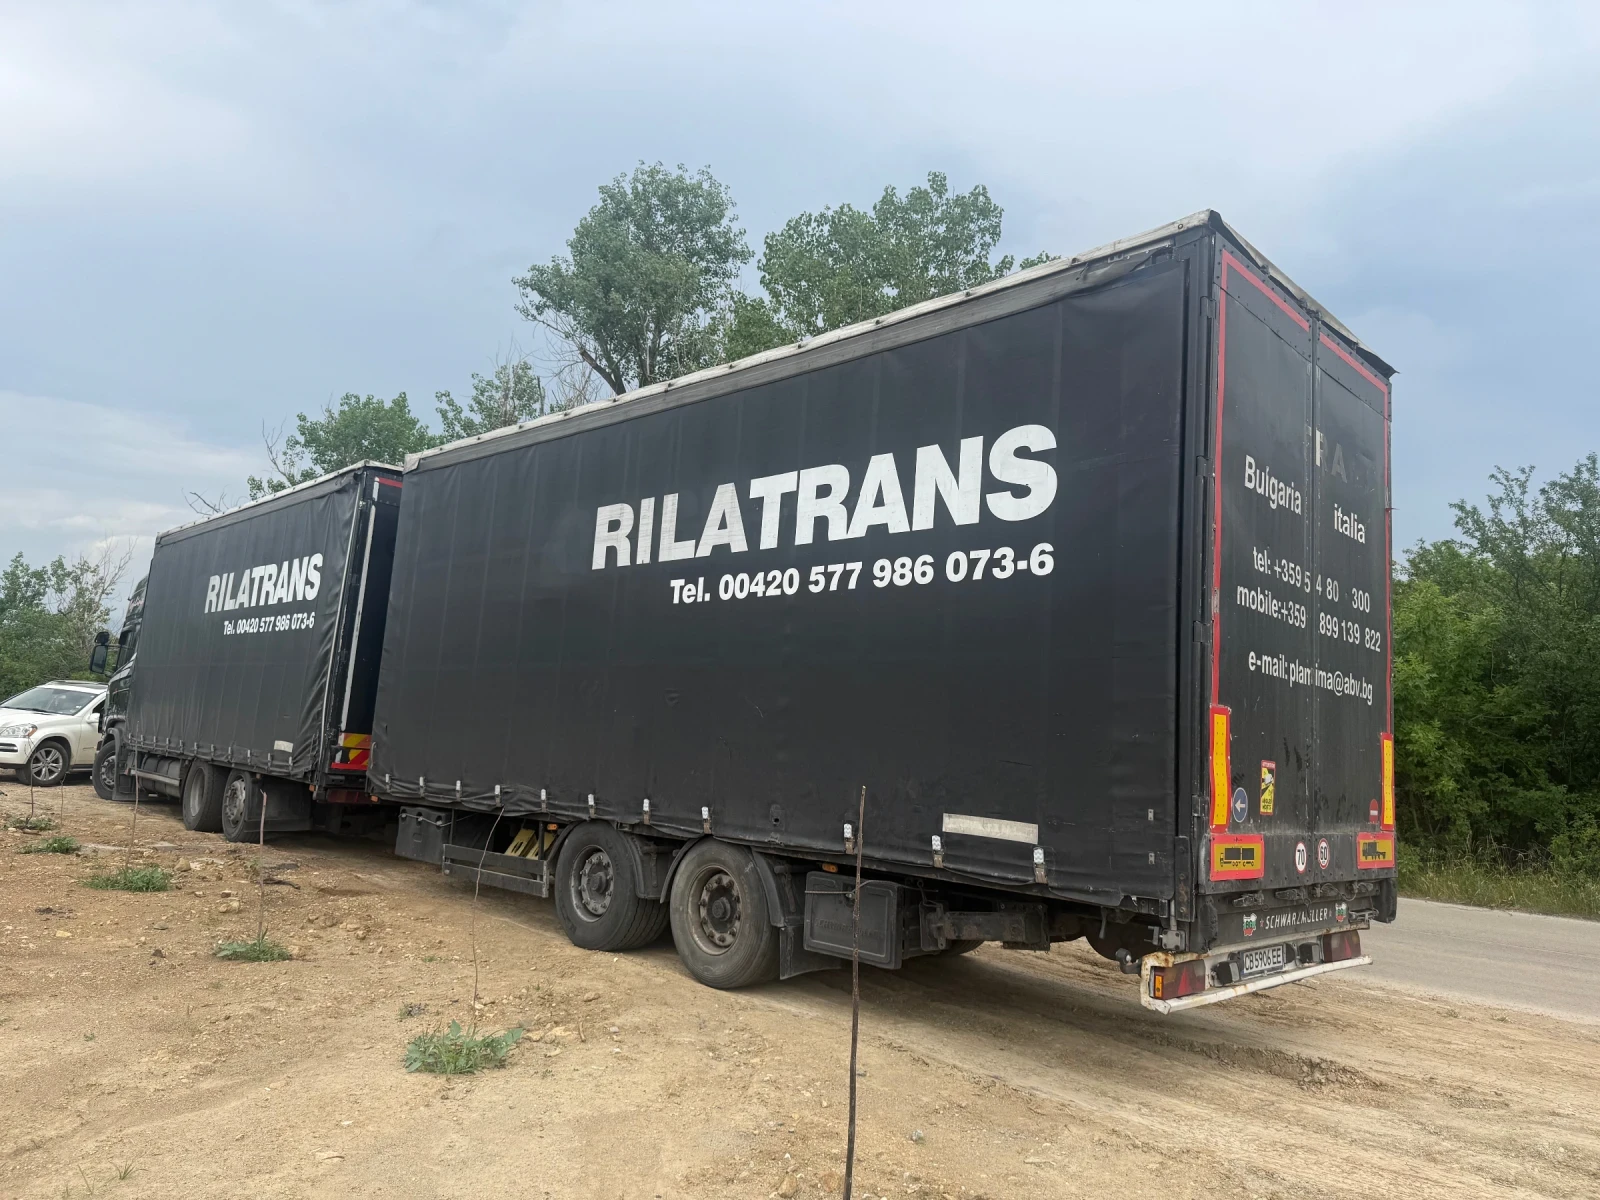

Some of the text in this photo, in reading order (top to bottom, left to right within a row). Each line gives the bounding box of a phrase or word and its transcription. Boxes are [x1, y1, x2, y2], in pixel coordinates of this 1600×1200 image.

[592, 424, 1058, 570] RILATRANS
[1244, 454, 1302, 516] Bulgaria
[1333, 503, 1366, 545] italia
[204, 552, 324, 614] RILATRANS
[670, 542, 1056, 604] Tel. 00420 577 986 073-6
[1252, 546, 1271, 575] tel:
[1273, 558, 1302, 588] +359
[1351, 587, 1371, 614] 300
[223, 611, 316, 636] Tel. 00420 577 986 073-6
[1319, 611, 1339, 639] 899
[1341, 619, 1361, 645] 139
[1364, 627, 1381, 653] 822
[1297, 848, 1305, 866] 70
